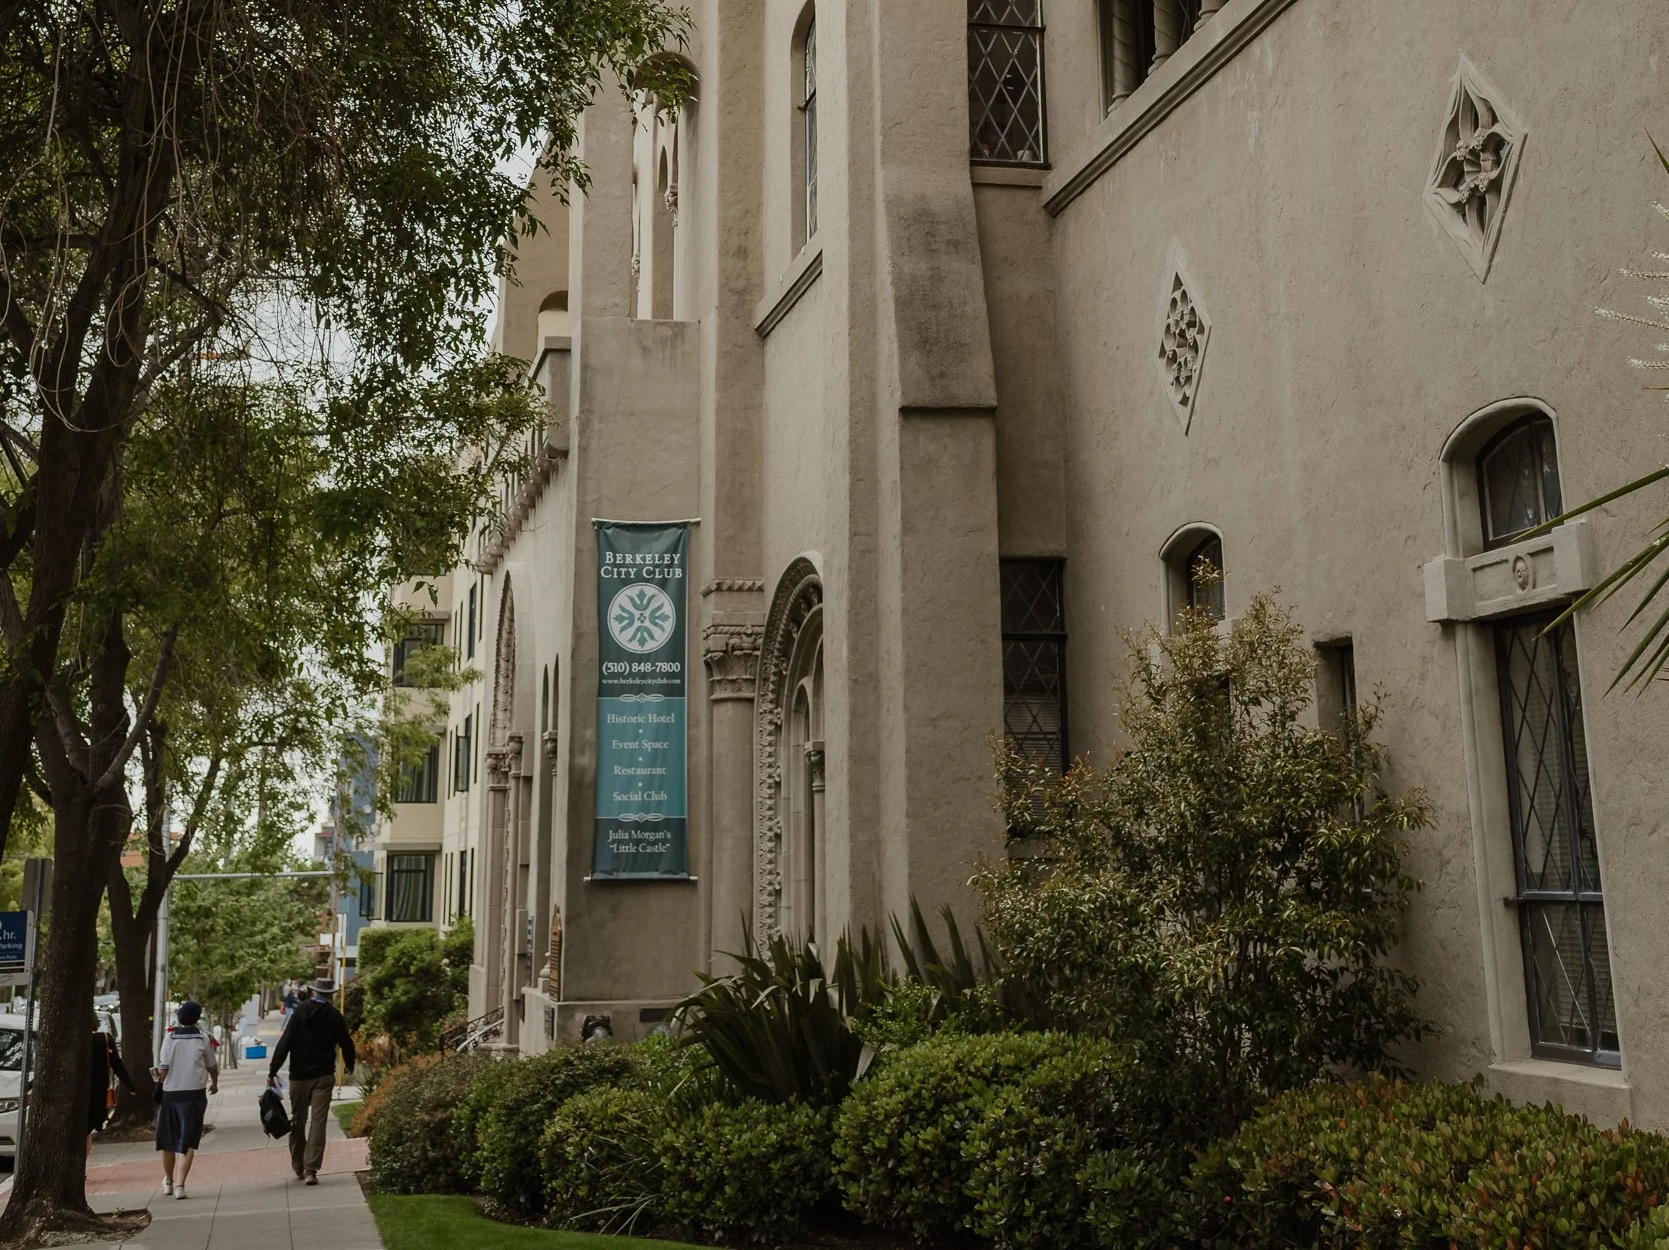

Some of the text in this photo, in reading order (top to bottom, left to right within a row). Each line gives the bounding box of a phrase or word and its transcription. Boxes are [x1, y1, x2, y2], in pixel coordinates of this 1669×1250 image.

[605, 552, 681, 565] BERKELEY
[600, 566, 683, 579] CITY CLUB
[602, 661, 681, 675] (510) 848-7800
[607, 713, 675, 724] Historic Hotel
[612, 739, 669, 751] Event Space
[614, 766, 667, 775] Restaurant
[612, 791, 668, 801] Social Club
[608, 829, 672, 842] Julia Morgan's
